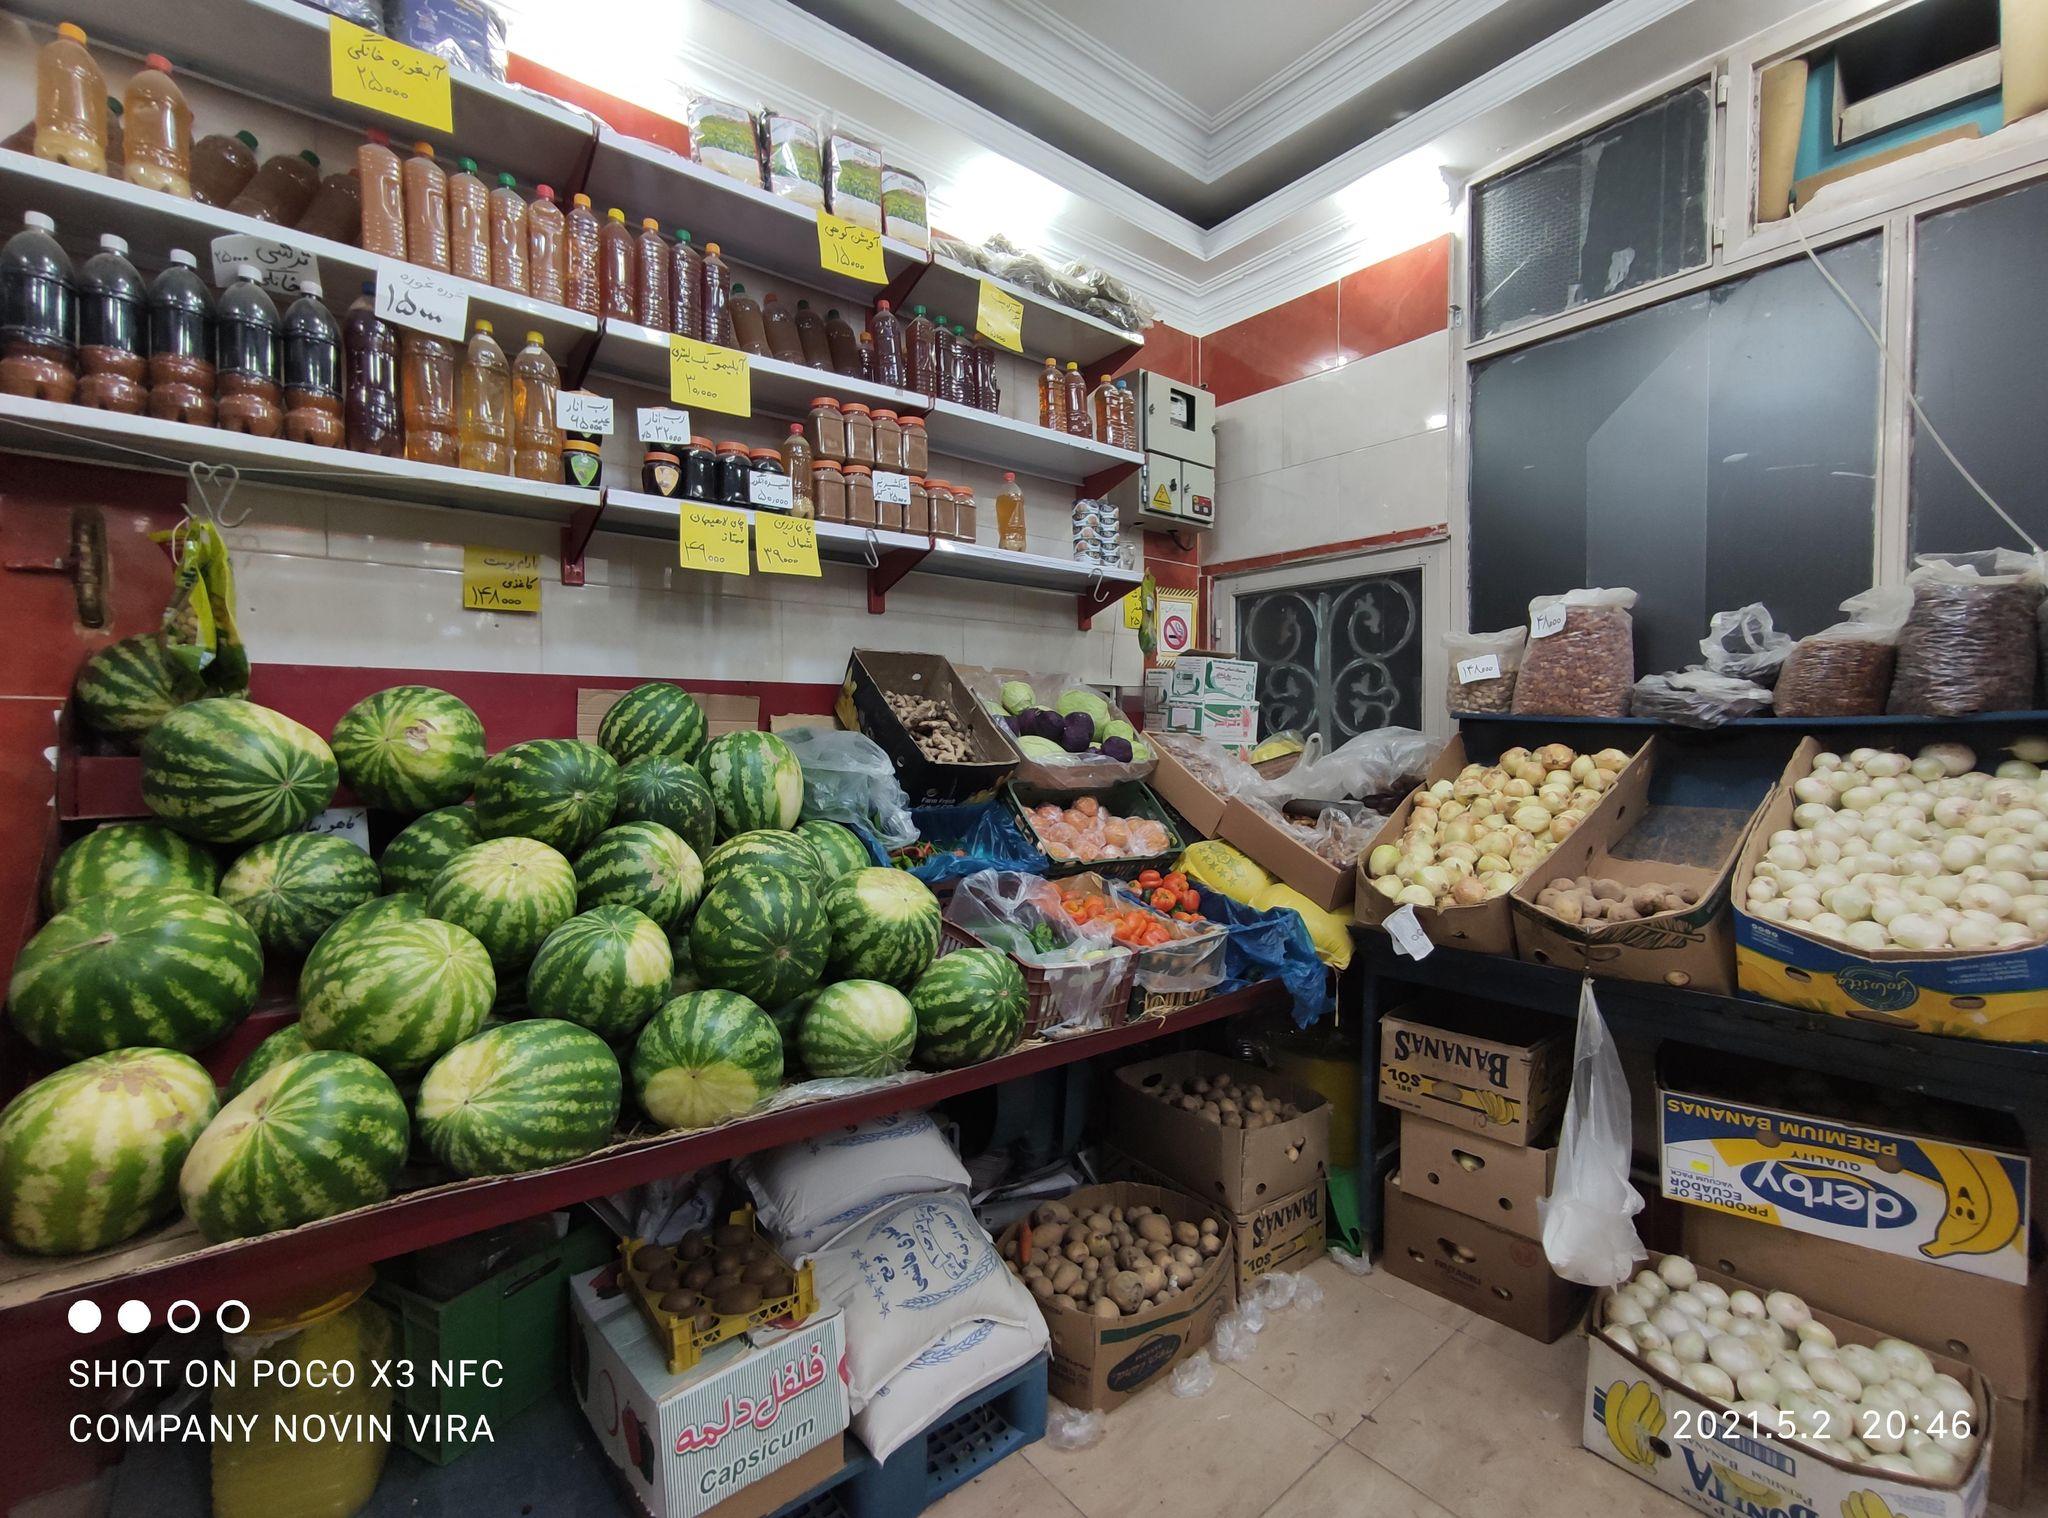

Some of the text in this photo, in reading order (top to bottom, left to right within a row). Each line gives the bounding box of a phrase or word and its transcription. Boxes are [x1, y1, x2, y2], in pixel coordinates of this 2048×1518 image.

[347, 33, 385, 62] خانگی
[356, 65, 409, 100] ۲۵۰۰۰
[255, 243, 314, 269] ترشی
[565, 398, 609, 414] رب انار
[644, 411, 687, 426] رب انار
[502, 575, 539, 590] کاغذی
[472, 586, 522, 606] ۱۴۸۰۰۰
[1394, 1029, 1510, 1089] BANANAS
[1387, 1068, 1422, 1088] SOL
[1667, 1099, 1898, 1157] PREMIUM BANANAS
[1790, 1150, 1862, 1172] QUALITY
[1669, 1169, 1735, 1190] VACUUM PACK
[1669, 1176, 1743, 1202] ECUADOR
[1670, 1186, 1769, 1218] PRODUCE OF
[1752, 1160, 1904, 1230] derby
[1247, 1252, 1272, 1272] SOL
[674, 1341, 827, 1454] فلفل دلمه
[700, 1417, 815, 1494] Capsicum
